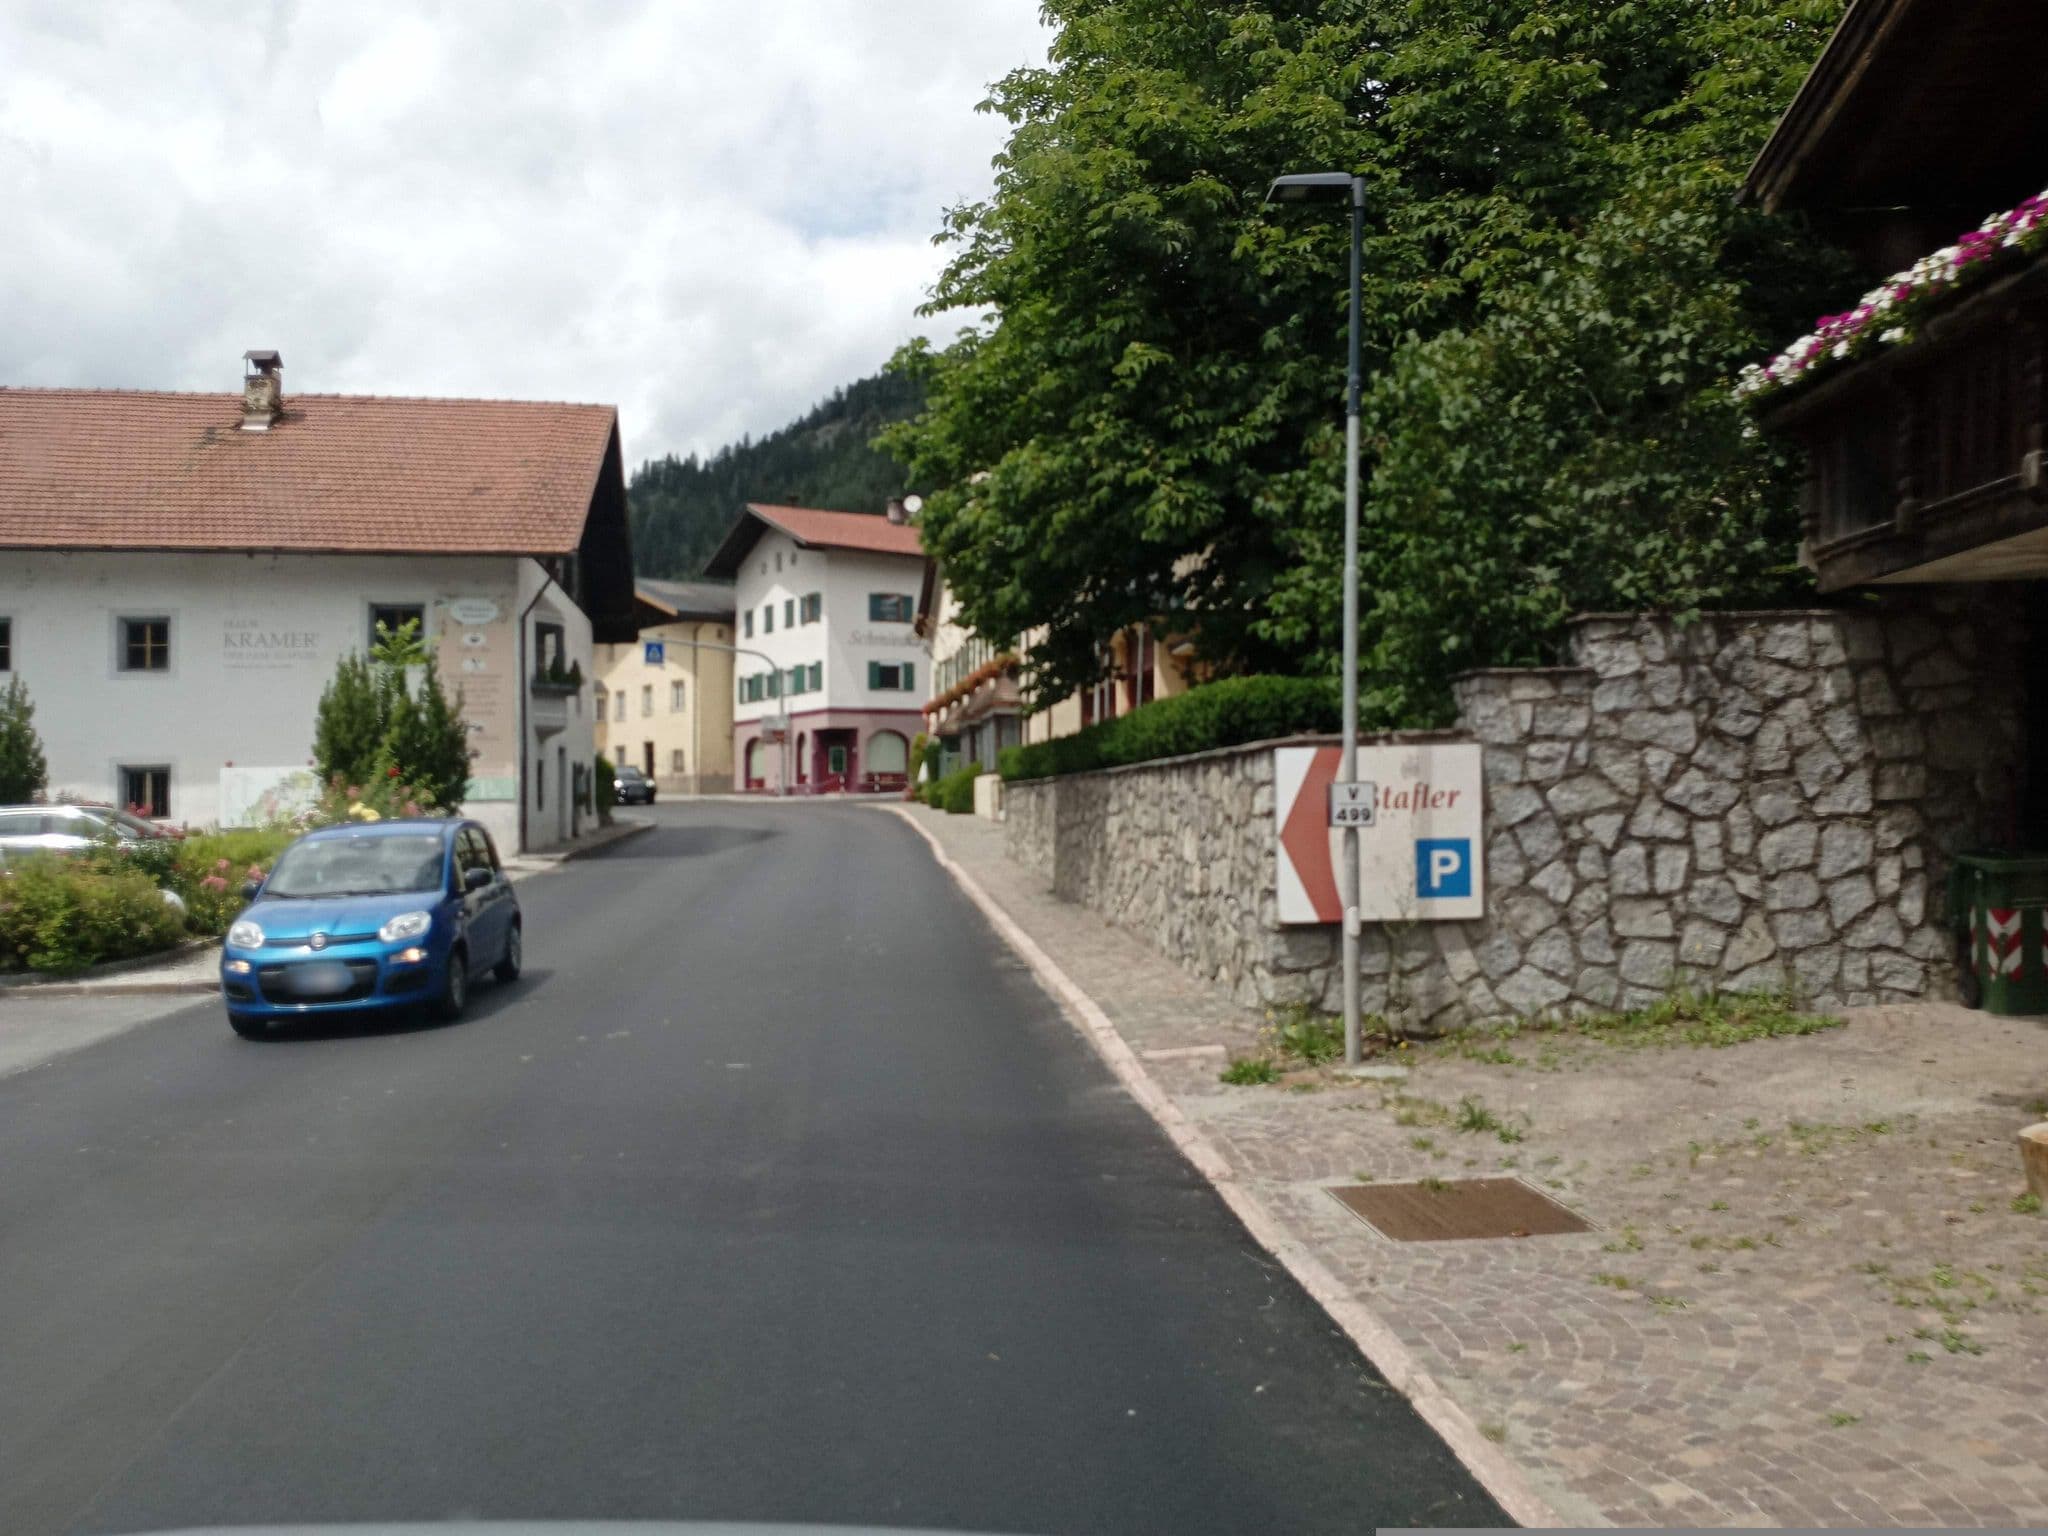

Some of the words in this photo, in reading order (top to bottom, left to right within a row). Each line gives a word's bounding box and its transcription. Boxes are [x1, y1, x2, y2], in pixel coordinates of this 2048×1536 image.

[224, 631, 317, 649] KRAMER
[1335, 807, 1371, 821] 499
[1430, 849, 1461, 889] P
